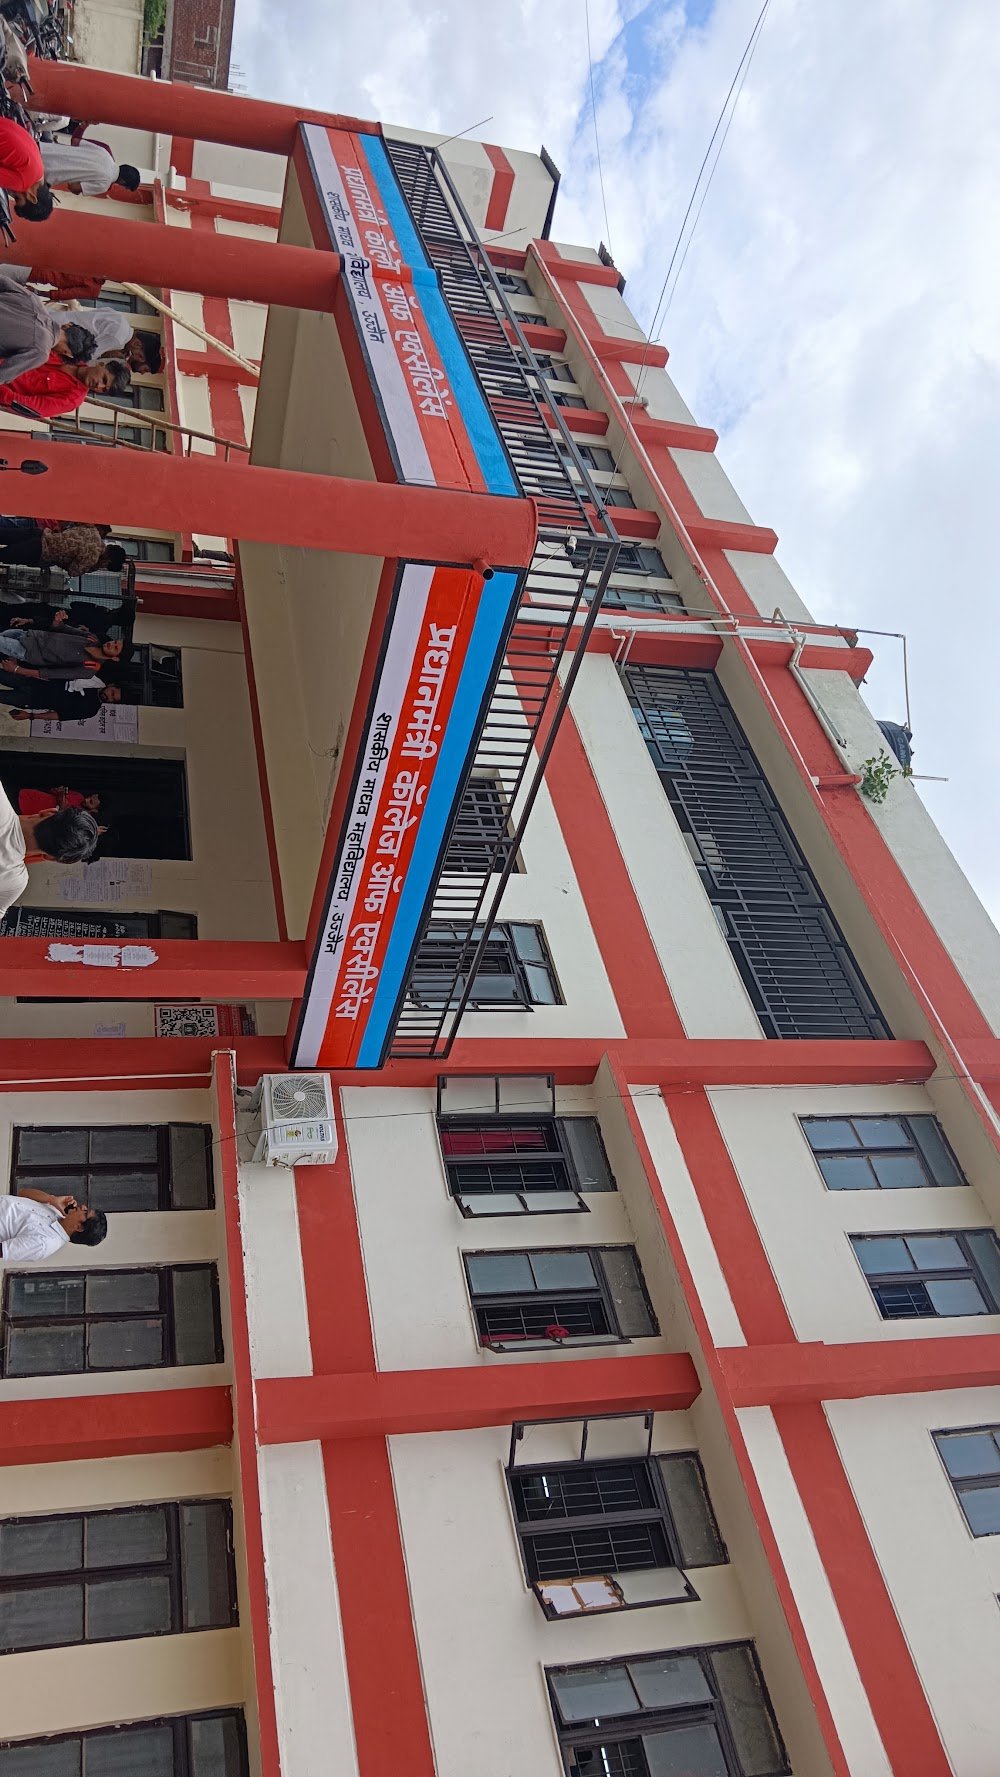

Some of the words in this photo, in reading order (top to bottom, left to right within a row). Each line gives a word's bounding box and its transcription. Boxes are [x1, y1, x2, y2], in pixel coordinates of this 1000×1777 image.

[327, 191, 350, 222] शासकीय
[339, 165, 389, 226] प्रधानमंत्री
[337, 226, 355, 248] माधव
[361, 310, 387, 343] उज्जैन
[382, 283, 417, 323] ऑफ
[395, 330, 453, 420] एक्सीलेंस
[400, 623, 457, 760] प्रधानमंत्री
[367, 712, 392, 773] शासकीय
[356, 778, 377, 816] माधव
[375, 770, 427, 856] कॉलेज
[363, 861, 402, 914] ऑफ
[324, 912, 345, 955] उज्जैन
[335, 920, 383, 1020] एक्सीलेंस
